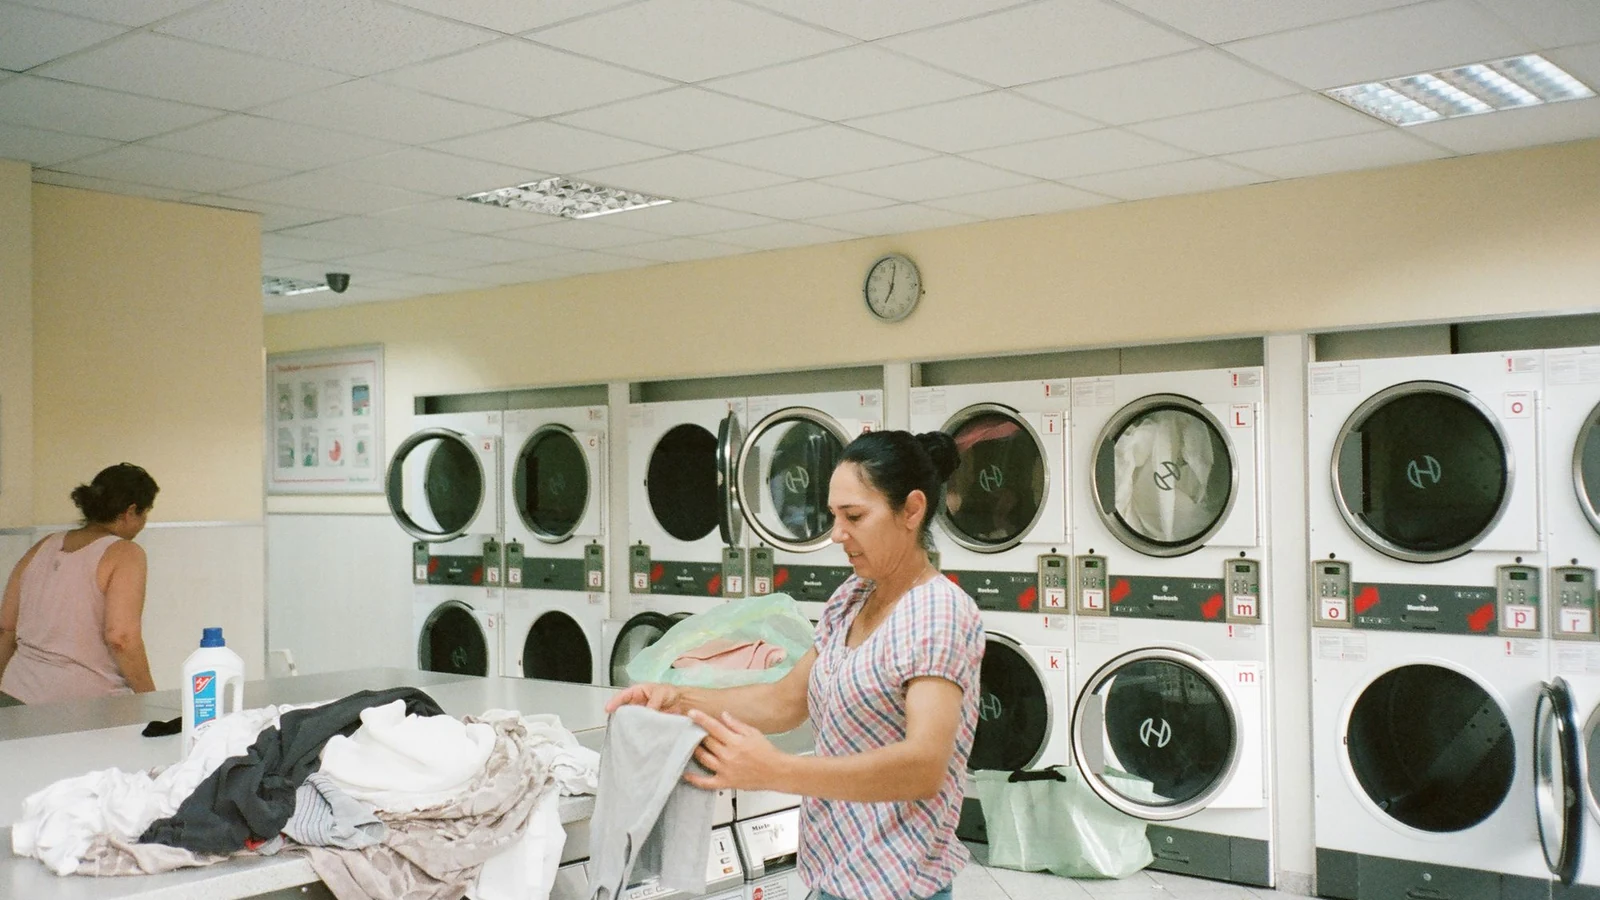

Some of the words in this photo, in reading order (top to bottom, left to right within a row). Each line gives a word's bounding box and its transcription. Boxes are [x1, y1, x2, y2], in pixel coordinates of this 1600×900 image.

[1236, 412, 1246, 425] L
[1049, 420, 1053, 433] i
[759, 583, 766, 593] g
[1051, 594, 1059, 607] k
[1090, 596, 1098, 609] L
[1237, 604, 1252, 616] m
[1328, 607, 1339, 618] o
[1514, 612, 1527, 628] p
[1571, 619, 1580, 631] r
[1050, 656, 1059, 669] k
[1238, 671, 1255, 682] m
